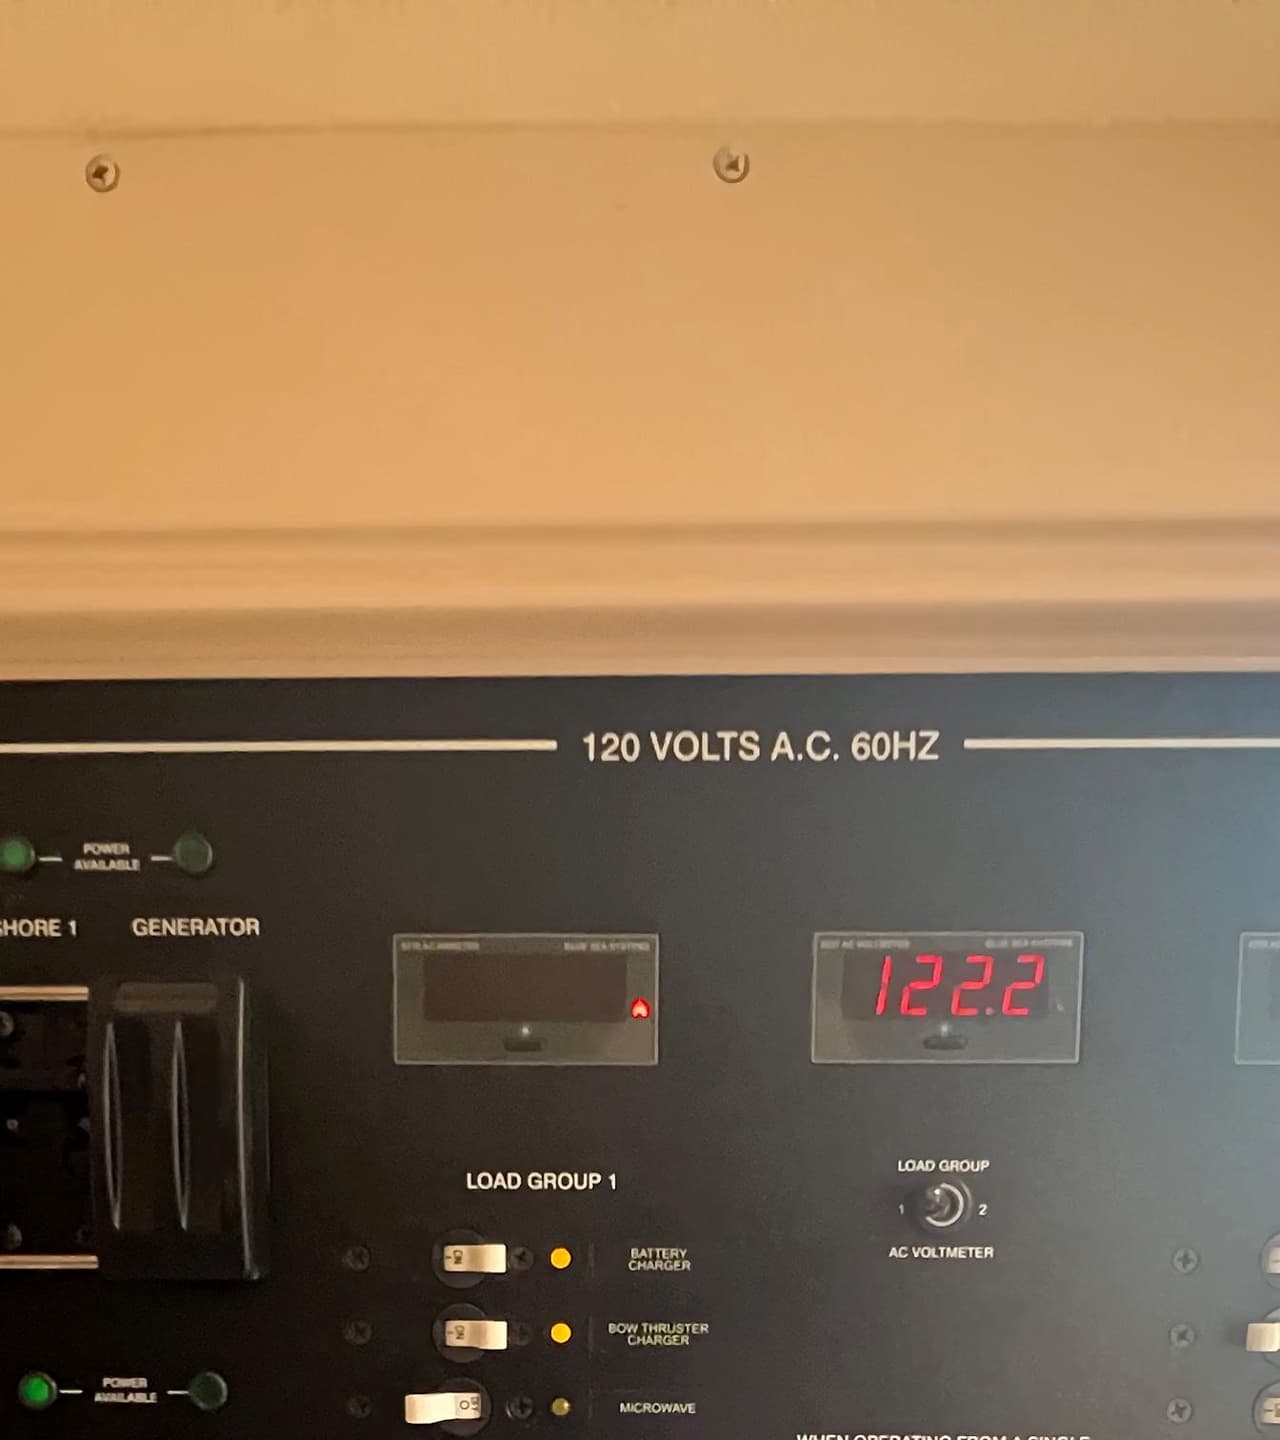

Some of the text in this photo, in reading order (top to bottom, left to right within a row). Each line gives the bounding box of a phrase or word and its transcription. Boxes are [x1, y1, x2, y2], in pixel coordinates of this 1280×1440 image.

[582, 730, 940, 763] 120 VOLTS A.C. 60HZ
[83, 843, 130, 855] POWER
[74, 859, 140, 871] AVAILABLE
[68, 920, 77, 935] 1
[132, 918, 260, 937] GENERATOR
[876, 954, 1045, 1015] 122.2
[898, 1160, 990, 1172] LOAD GROUP
[467, 1172, 617, 1190] LOAD GROUP 1
[899, 1205, 904, 1214] 1
[979, 1205, 987, 1215] 2
[631, 1248, 687, 1260] BATTERY
[889, 1247, 994, 1258] AC VOLTMETER
[628, 1260, 691, 1272] CHARGER
[609, 1323, 709, 1334] BOW THRUSTER
[628, 1335, 689, 1346] CHARGER
[620, 1402, 696, 1414] MICROWAVE
